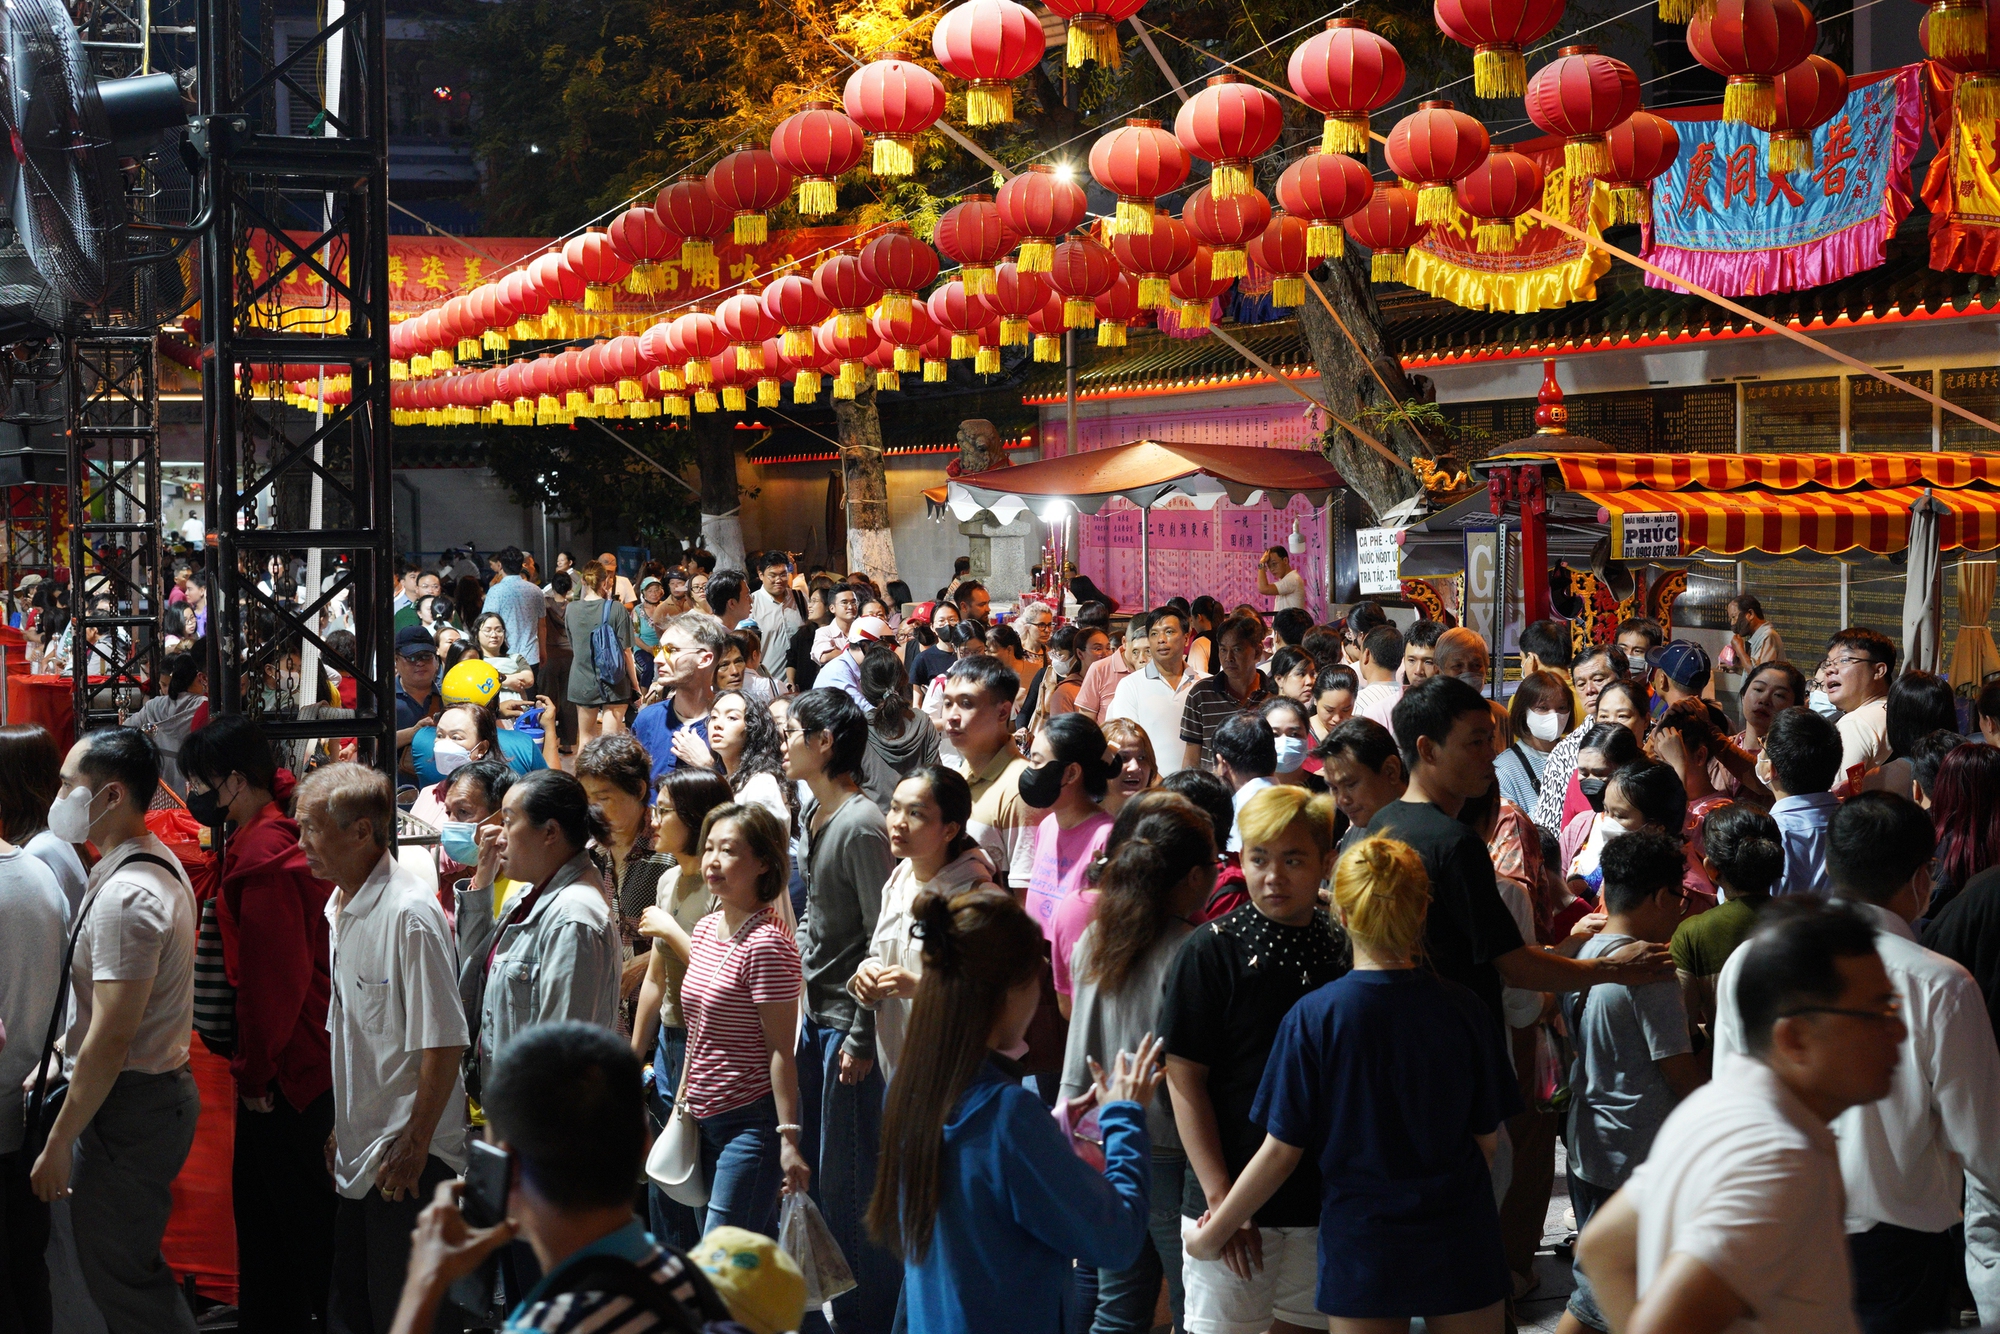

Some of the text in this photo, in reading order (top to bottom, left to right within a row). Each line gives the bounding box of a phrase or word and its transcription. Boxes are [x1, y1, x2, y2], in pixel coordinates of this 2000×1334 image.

[1625, 524, 1677, 544] PHÚC
[1636, 546, 1652, 557] 0903
[1653, 545, 1664, 557] 837
[1665, 544, 1677, 556] 502
